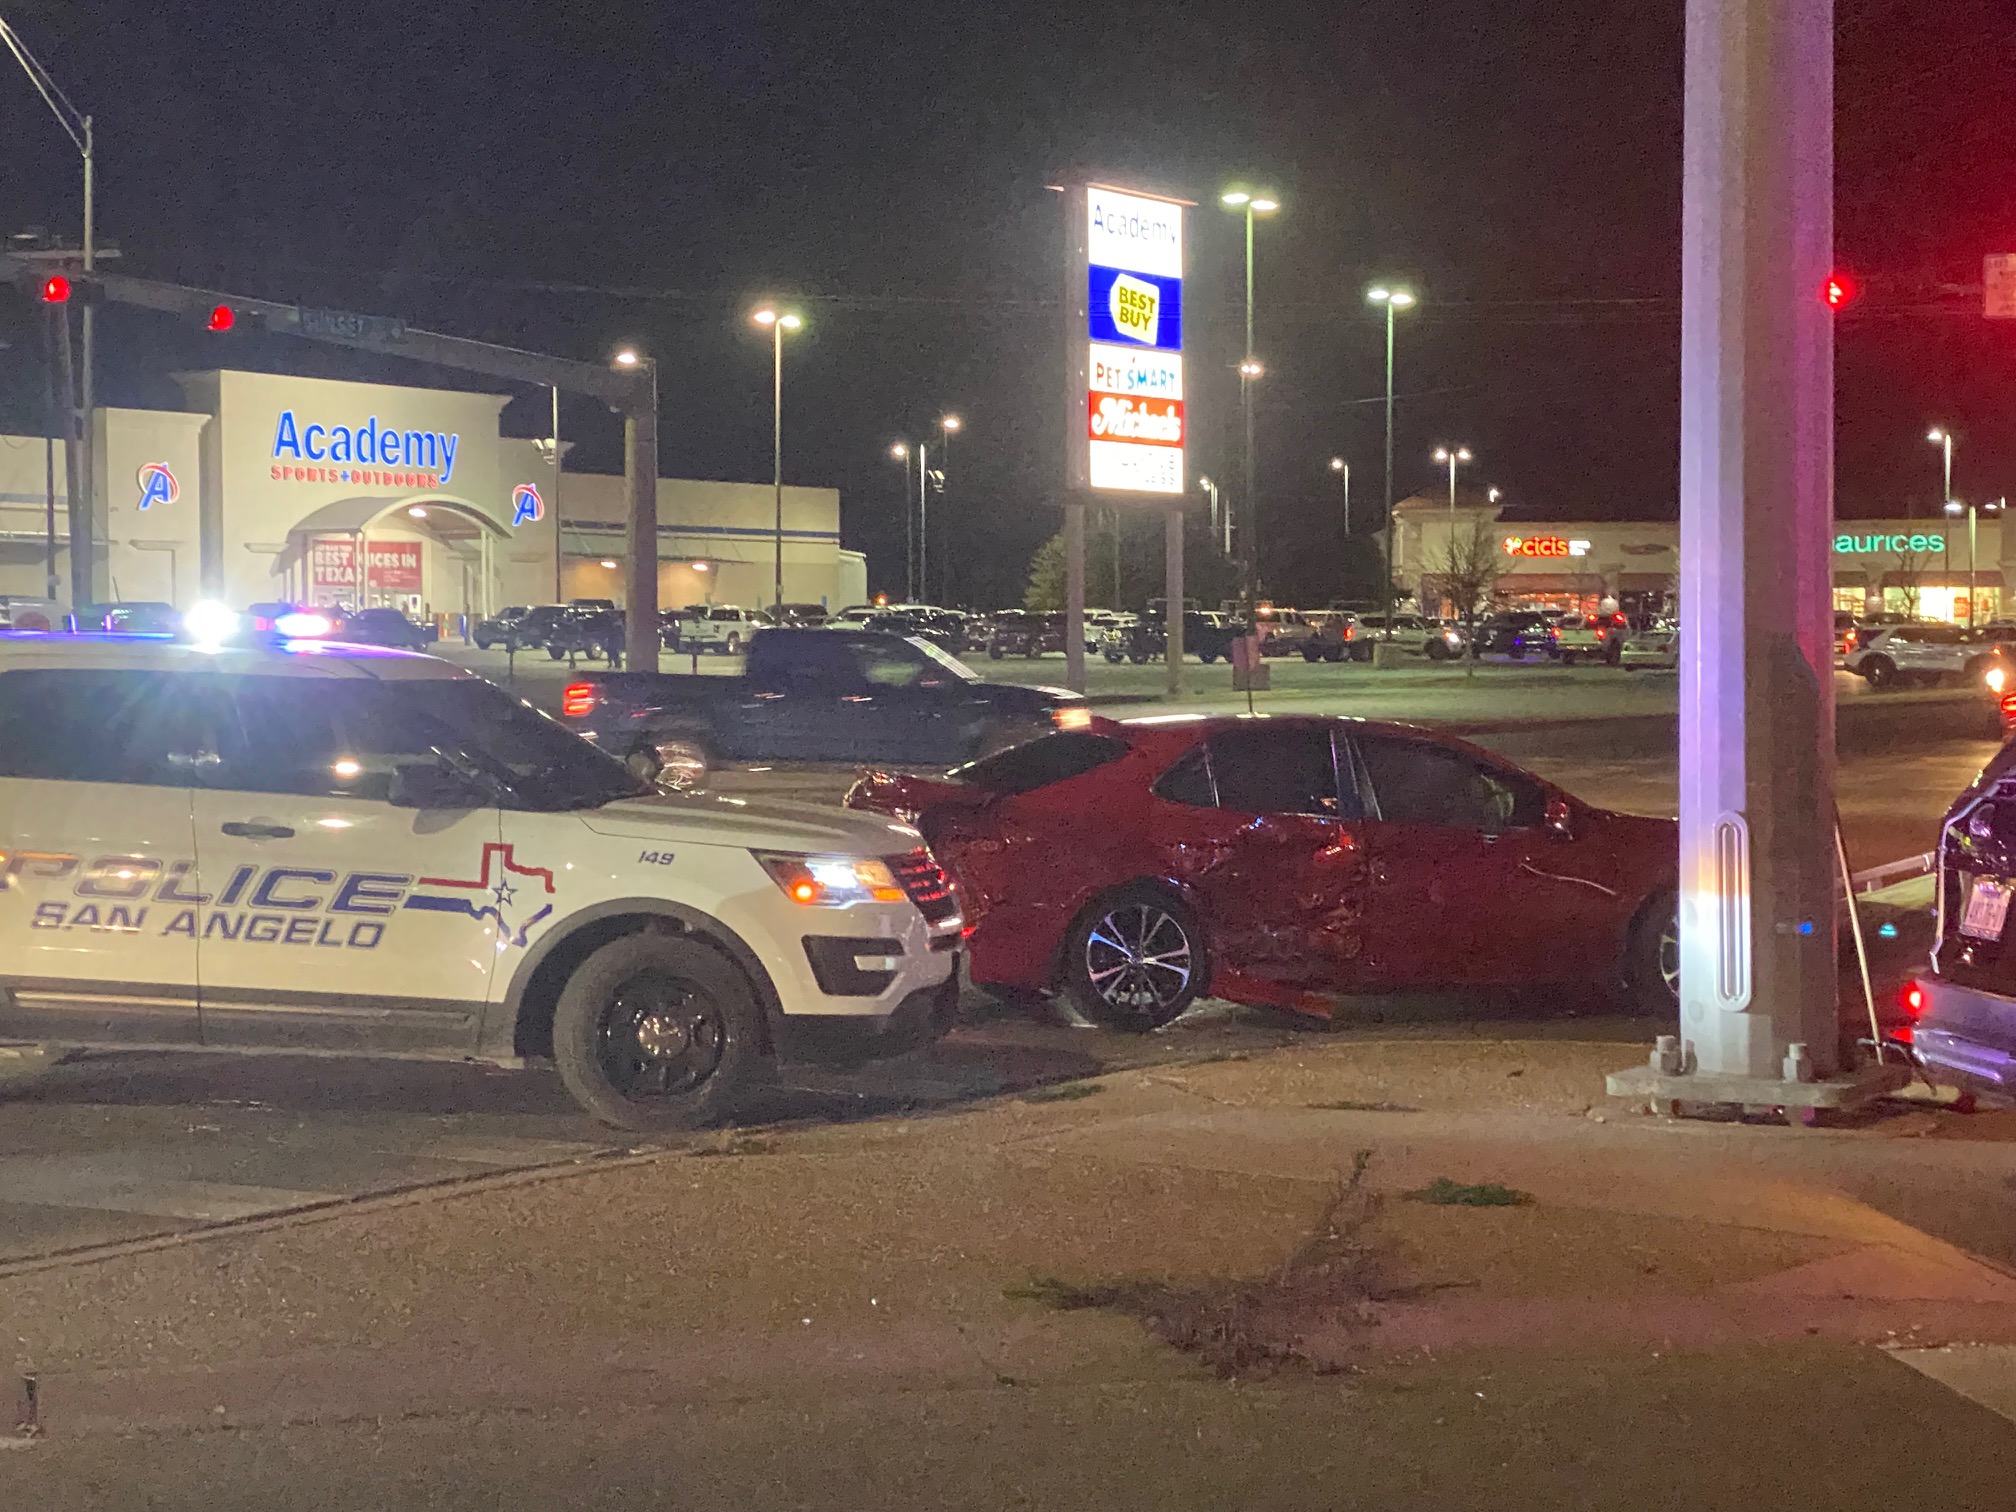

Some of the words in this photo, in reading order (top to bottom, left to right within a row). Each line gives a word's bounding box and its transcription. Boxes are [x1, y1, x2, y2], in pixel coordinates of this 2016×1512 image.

[1094, 204, 1176, 244] Academy
[1119, 285, 1156, 315] BEST
[1119, 306, 1152, 331] BUY
[272, 409, 459, 484] Academy
[1522, 536, 1568, 556] cicis
[1832, 534, 1945, 553] aurices
[314, 551, 350, 566] BEST
[401, 554, 417, 568] IN
[638, 851, 674, 865] 149
[0, 852, 413, 915] POLICE
[31, 902, 149, 936] SAN
[159, 910, 386, 949] ANGELO
